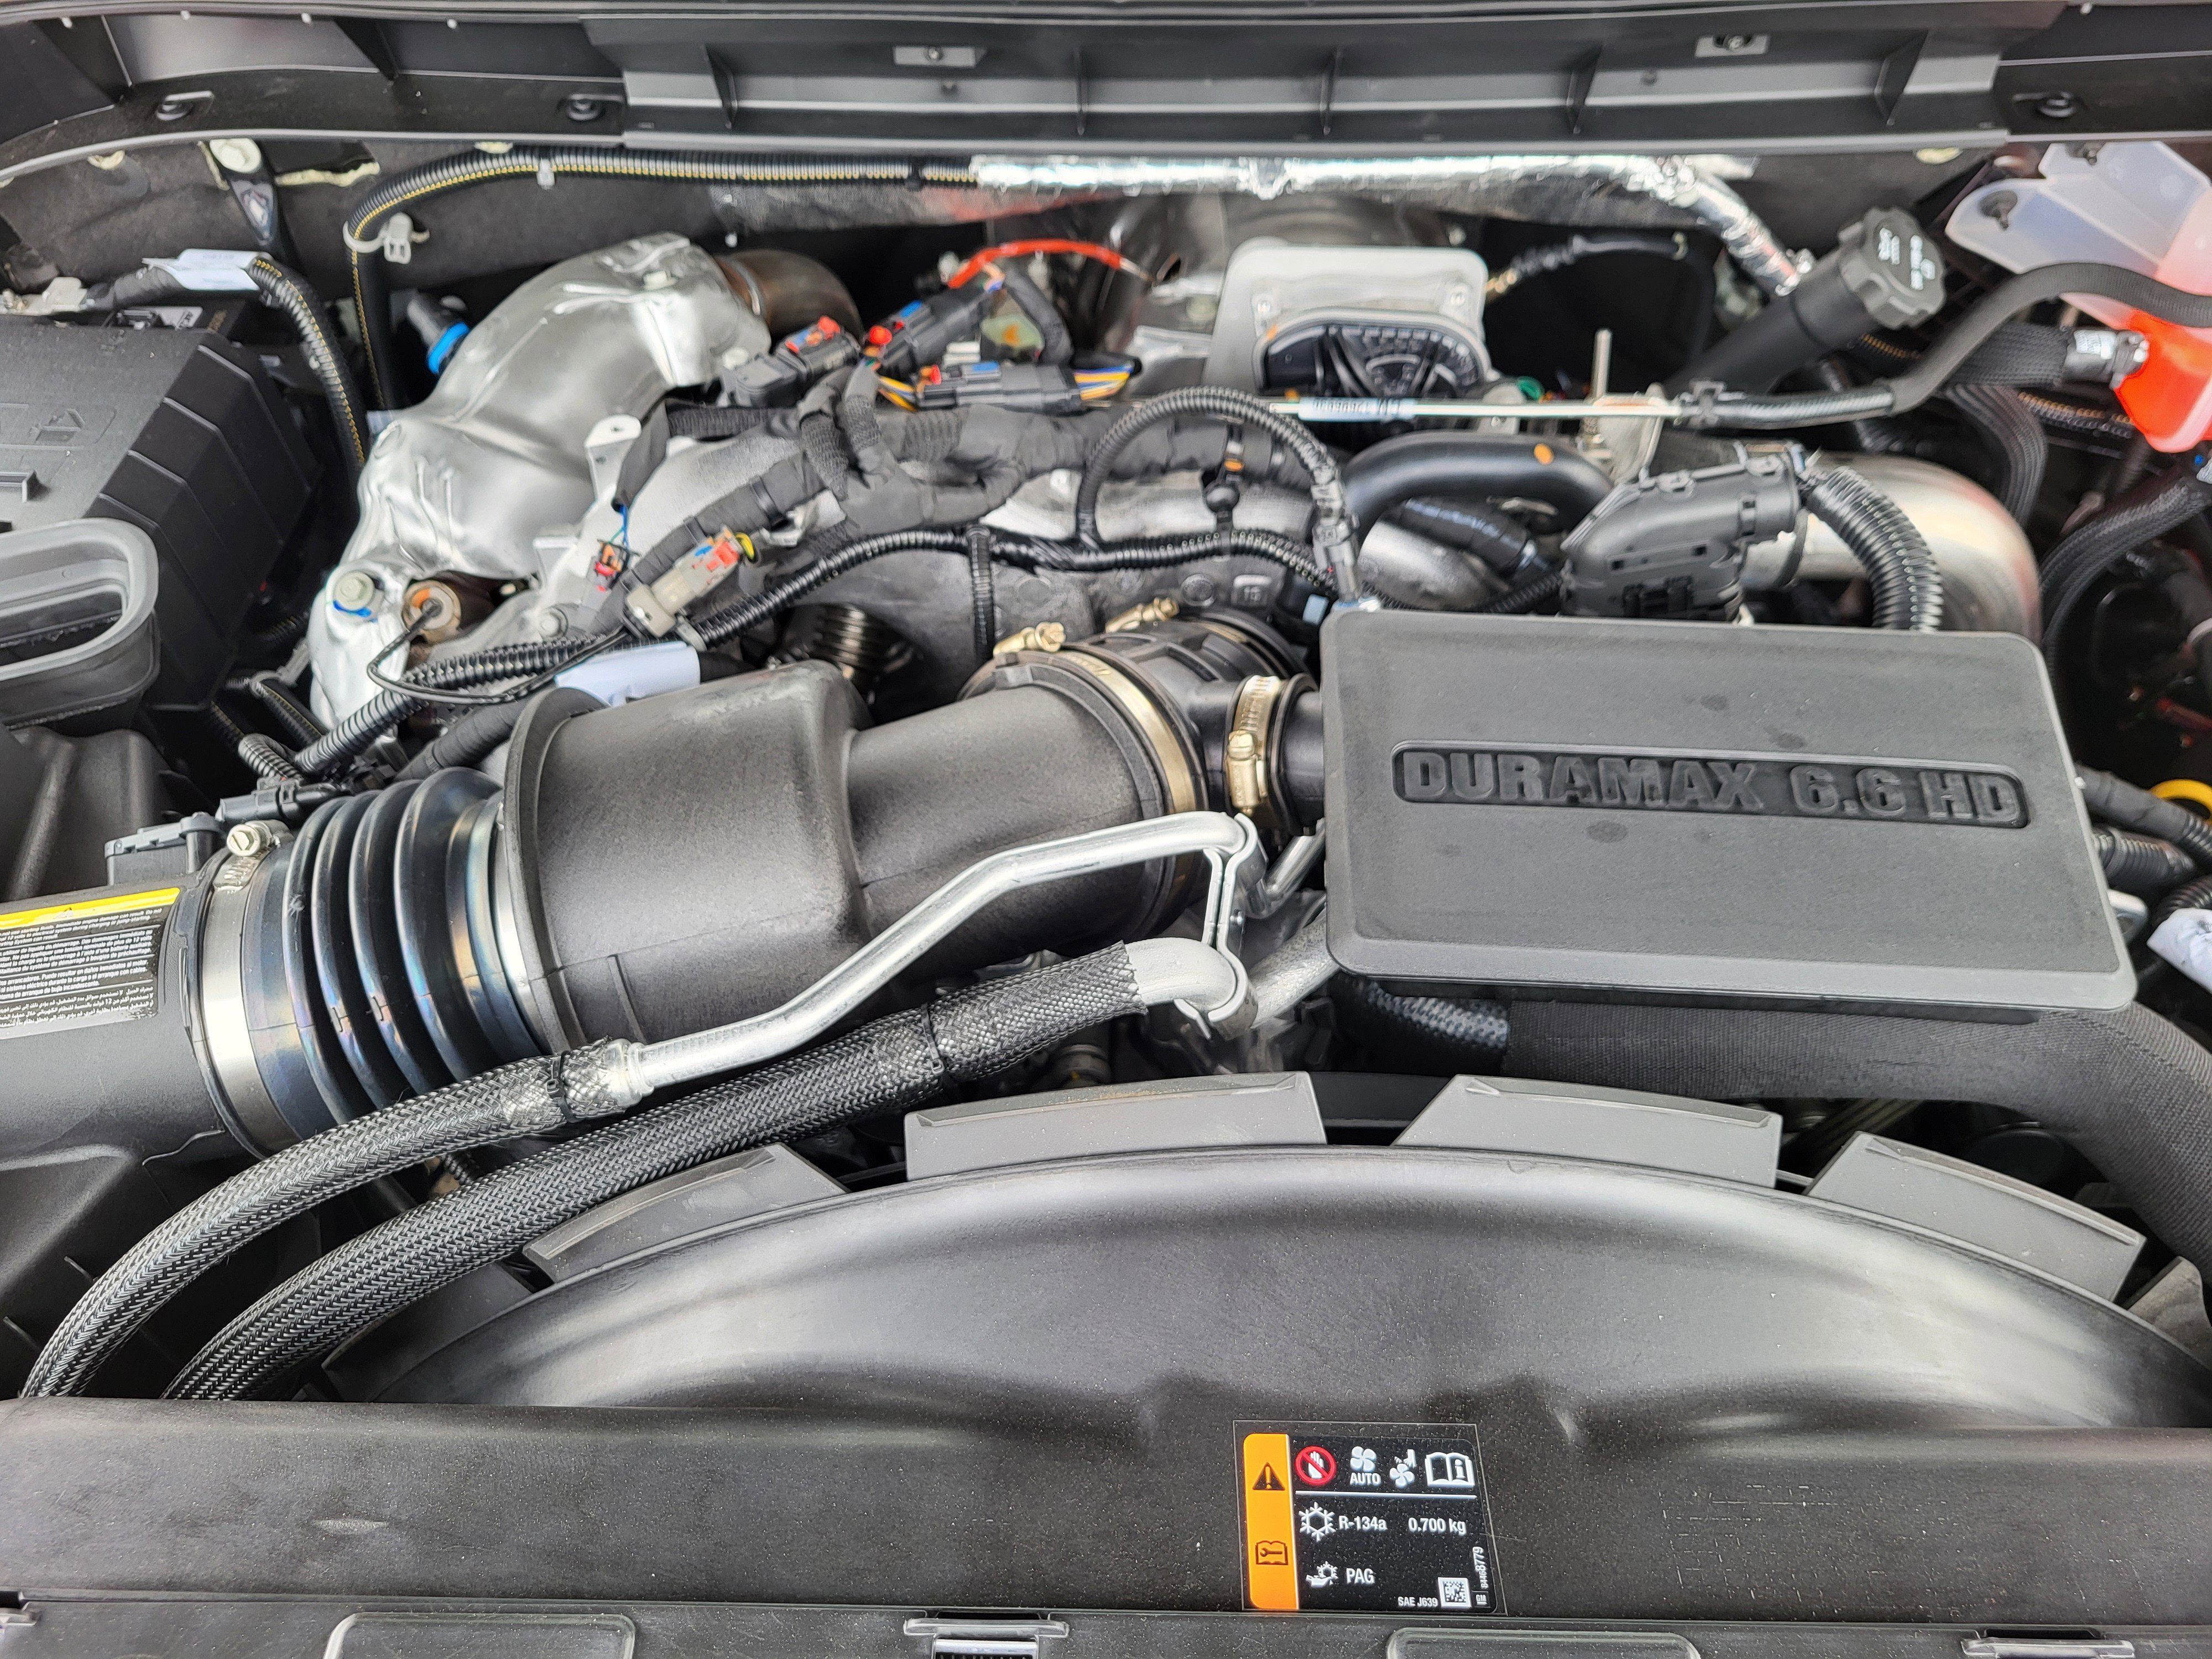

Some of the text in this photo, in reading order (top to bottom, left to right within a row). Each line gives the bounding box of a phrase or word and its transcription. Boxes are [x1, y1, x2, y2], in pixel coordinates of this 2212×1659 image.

[1402, 752, 2022, 823] DURAMAX 6.6 HD
[92, 935, 119, 943] dommages
[29, 962, 50, 971] système
[58, 957, 85, 966] démarrage
[49, 953, 76, 961] démarrage
[7, 975, 41, 985] arrancadores.
[100, 963, 126, 971] inmediatos
[97, 971, 119, 979] arranque
[22, 989, 43, 997] arranque
[63, 981, 100, 990] incandescente.
[1349, 1472, 1381, 1486] AUTO
[1338, 1515, 1467, 1536] R-134a 0.700 kg
[1346, 1568, 1375, 1584] PAG
[1397, 1597, 1438, 1608] SAE J639
[1475, 1594, 1487, 1605] GM
